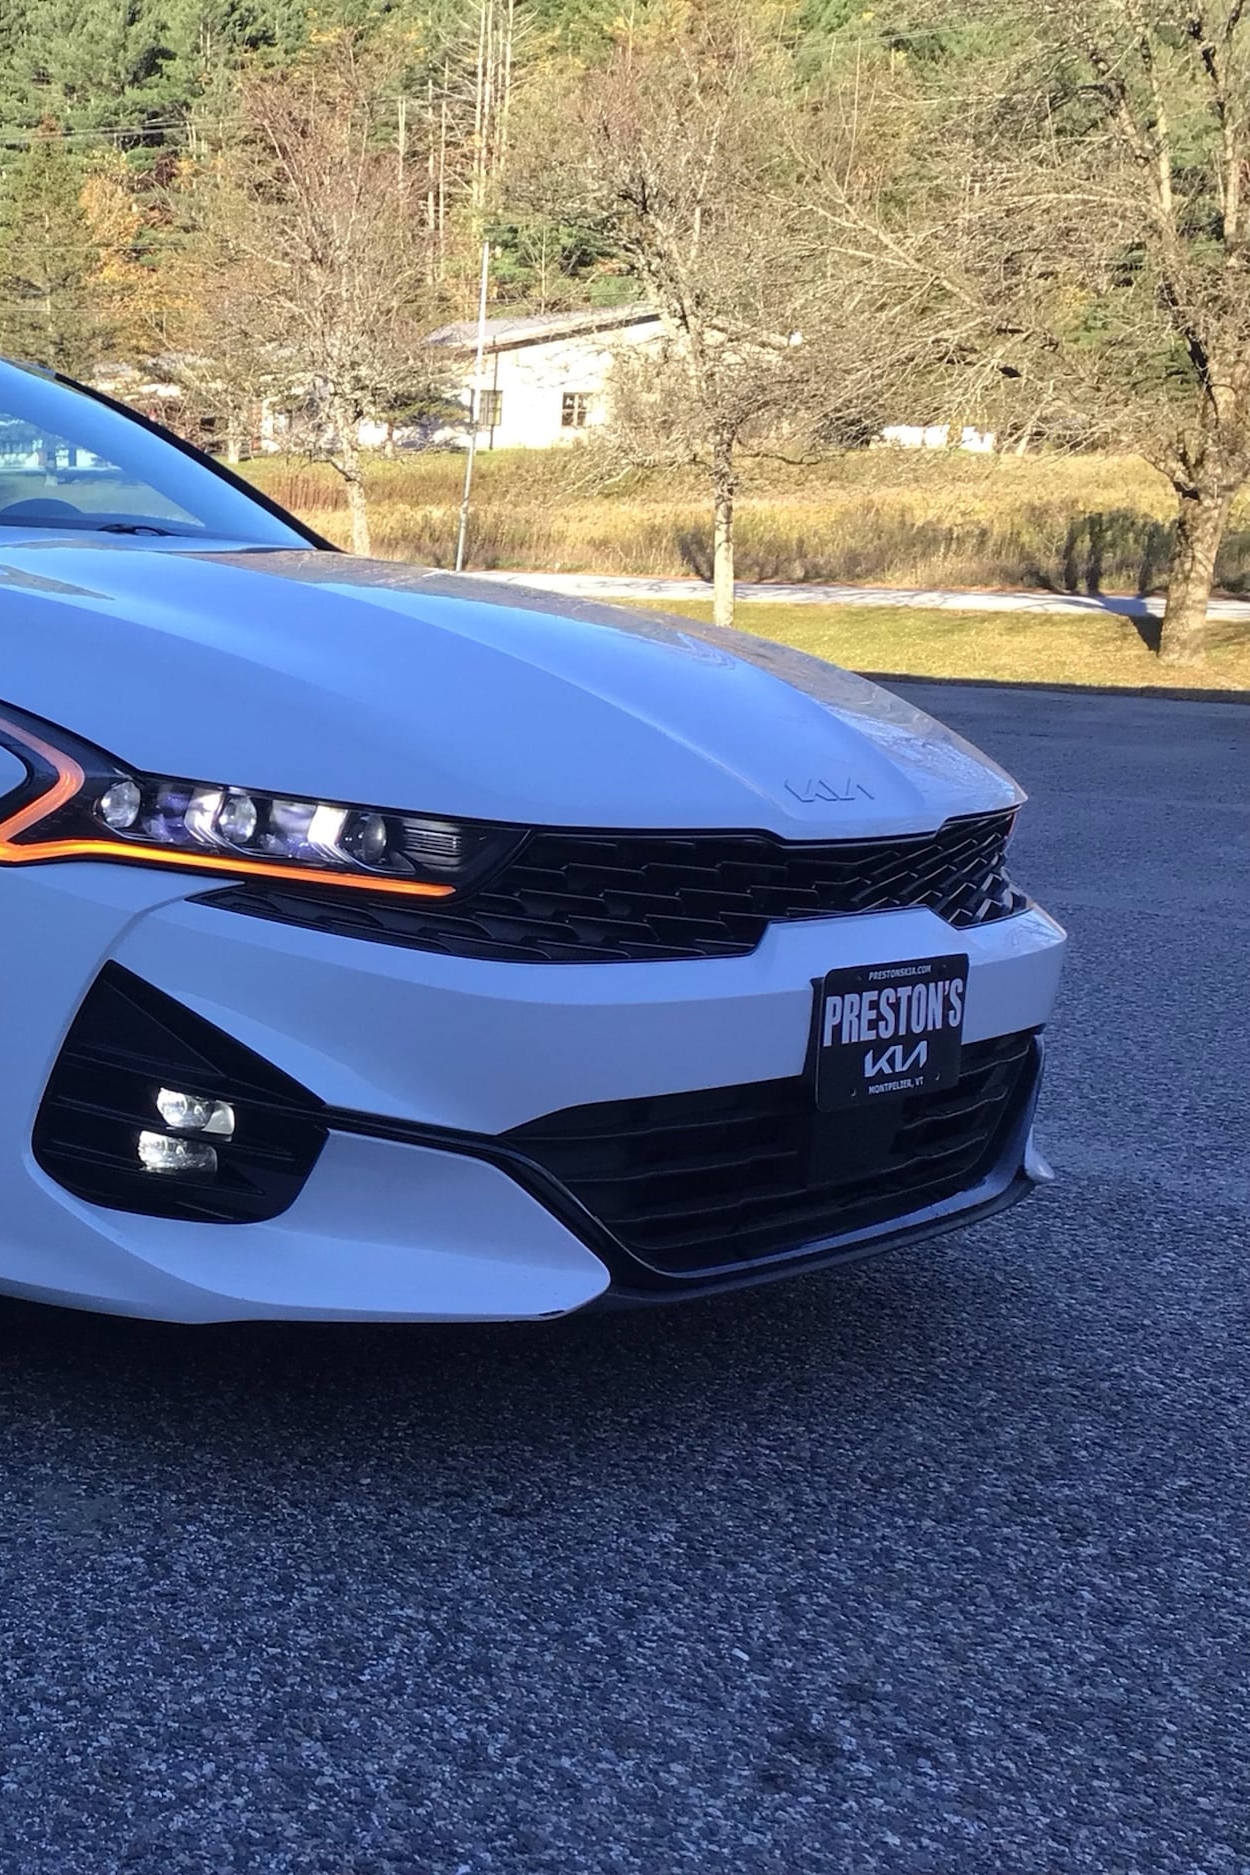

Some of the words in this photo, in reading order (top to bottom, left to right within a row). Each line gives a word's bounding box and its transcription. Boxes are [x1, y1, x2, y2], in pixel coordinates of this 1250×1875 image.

[868, 965, 932, 981] PRESTONSKIA.COM
[822, 978, 963, 1047] PRESTON'S
[864, 1040, 928, 1078] KIA
[868, 1079, 915, 1095] MONTPELIER,
[915, 1076, 924, 1086] VT
